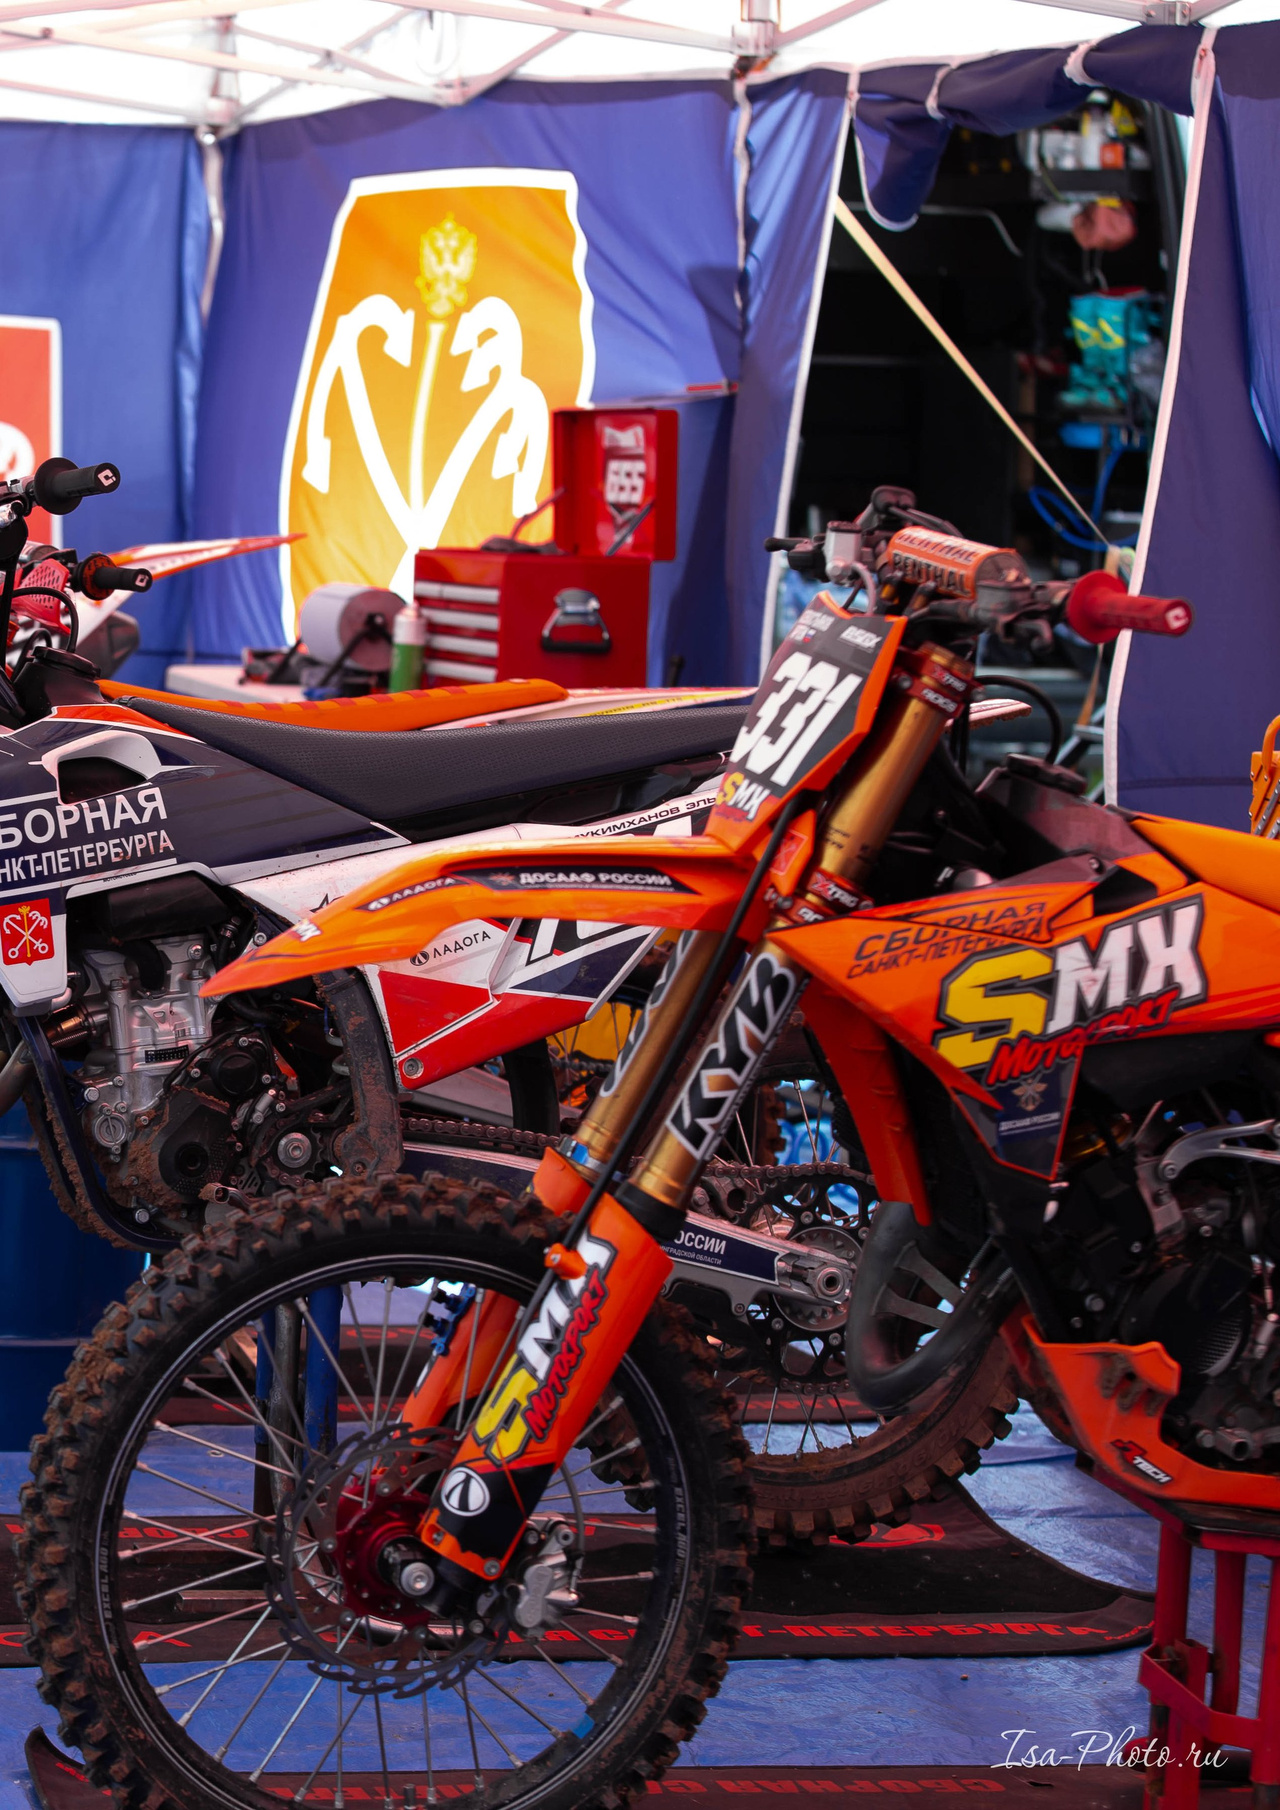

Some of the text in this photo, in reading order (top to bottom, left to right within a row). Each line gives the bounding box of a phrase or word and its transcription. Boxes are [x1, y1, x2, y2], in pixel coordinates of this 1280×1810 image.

[729, 651, 863, 787] 331
[715, 771, 772, 821] SMX
[573, 806, 681, 838] УКИМХАНОВ
[520, 871, 672, 886] ДОСААФ РОССИИ
[432, 930, 492, 959] ЛАДОГА
[935, 897, 1206, 1071] SMX
[666, 951, 797, 1160] KYB
[985, 986, 1180, 1087] MOTORSPORT
[673, 1230, 727, 1255] ОССИИ
